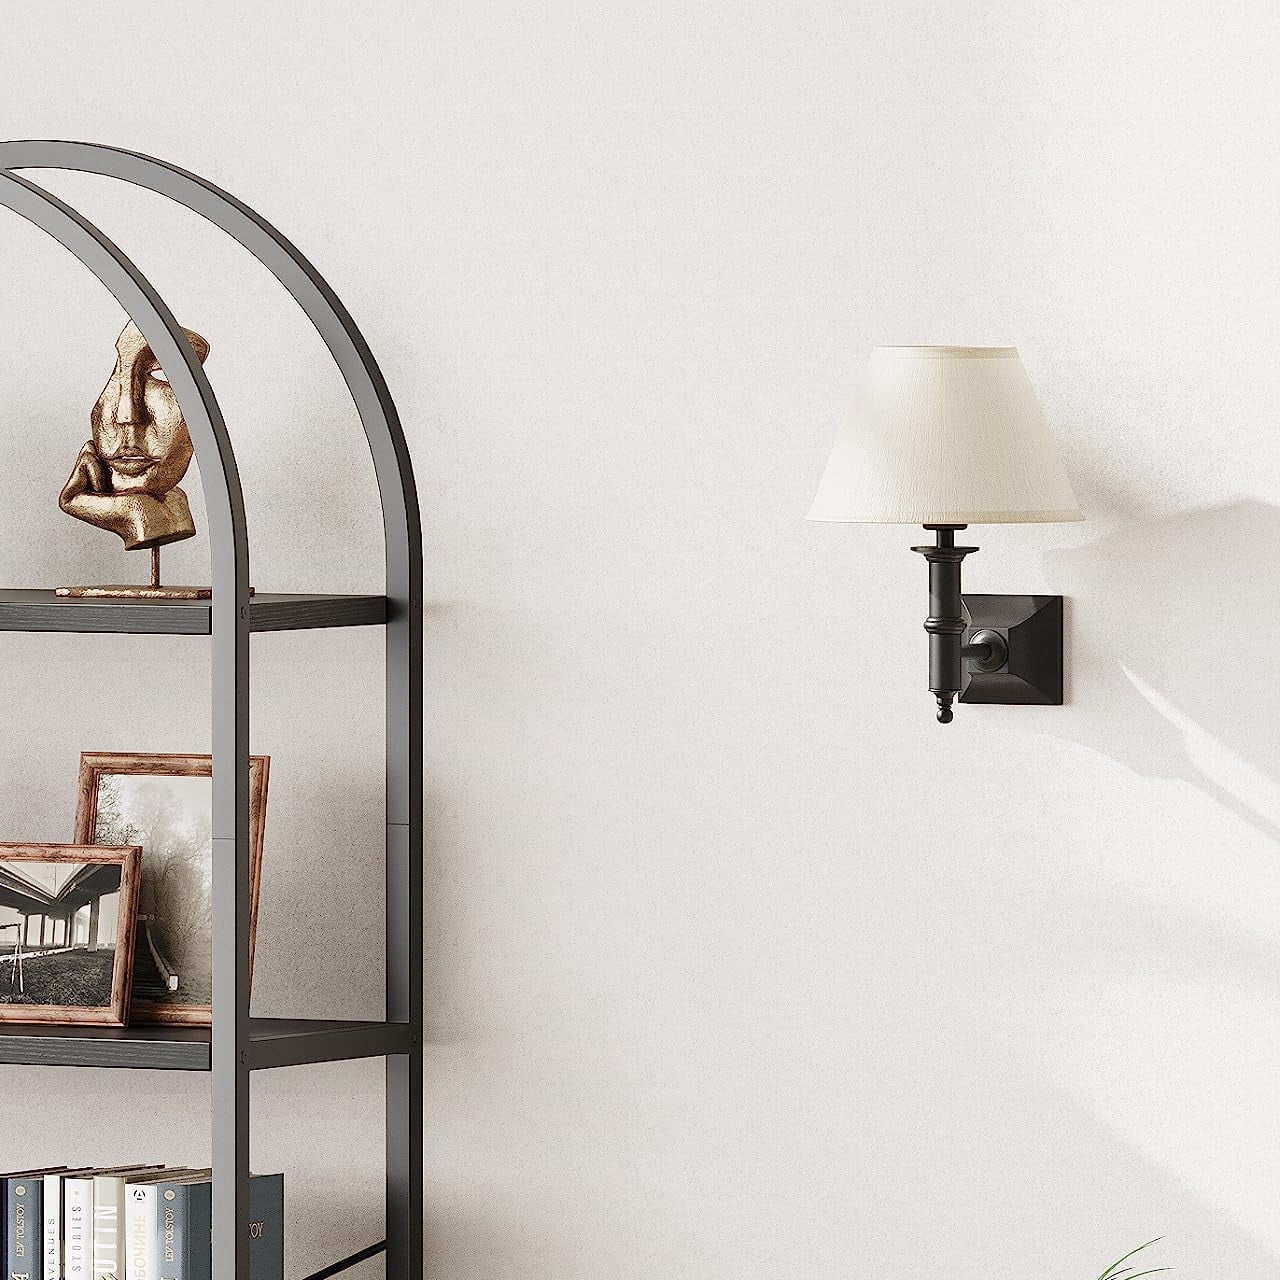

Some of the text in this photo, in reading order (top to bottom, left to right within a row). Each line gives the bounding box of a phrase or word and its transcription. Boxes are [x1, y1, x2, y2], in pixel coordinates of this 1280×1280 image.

[16, 1203, 25, 1257] LEV TOLSTOY
[71, 1206, 82, 1272] STORIES
[165, 1207, 174, 1262] LEV TOLSTOY
